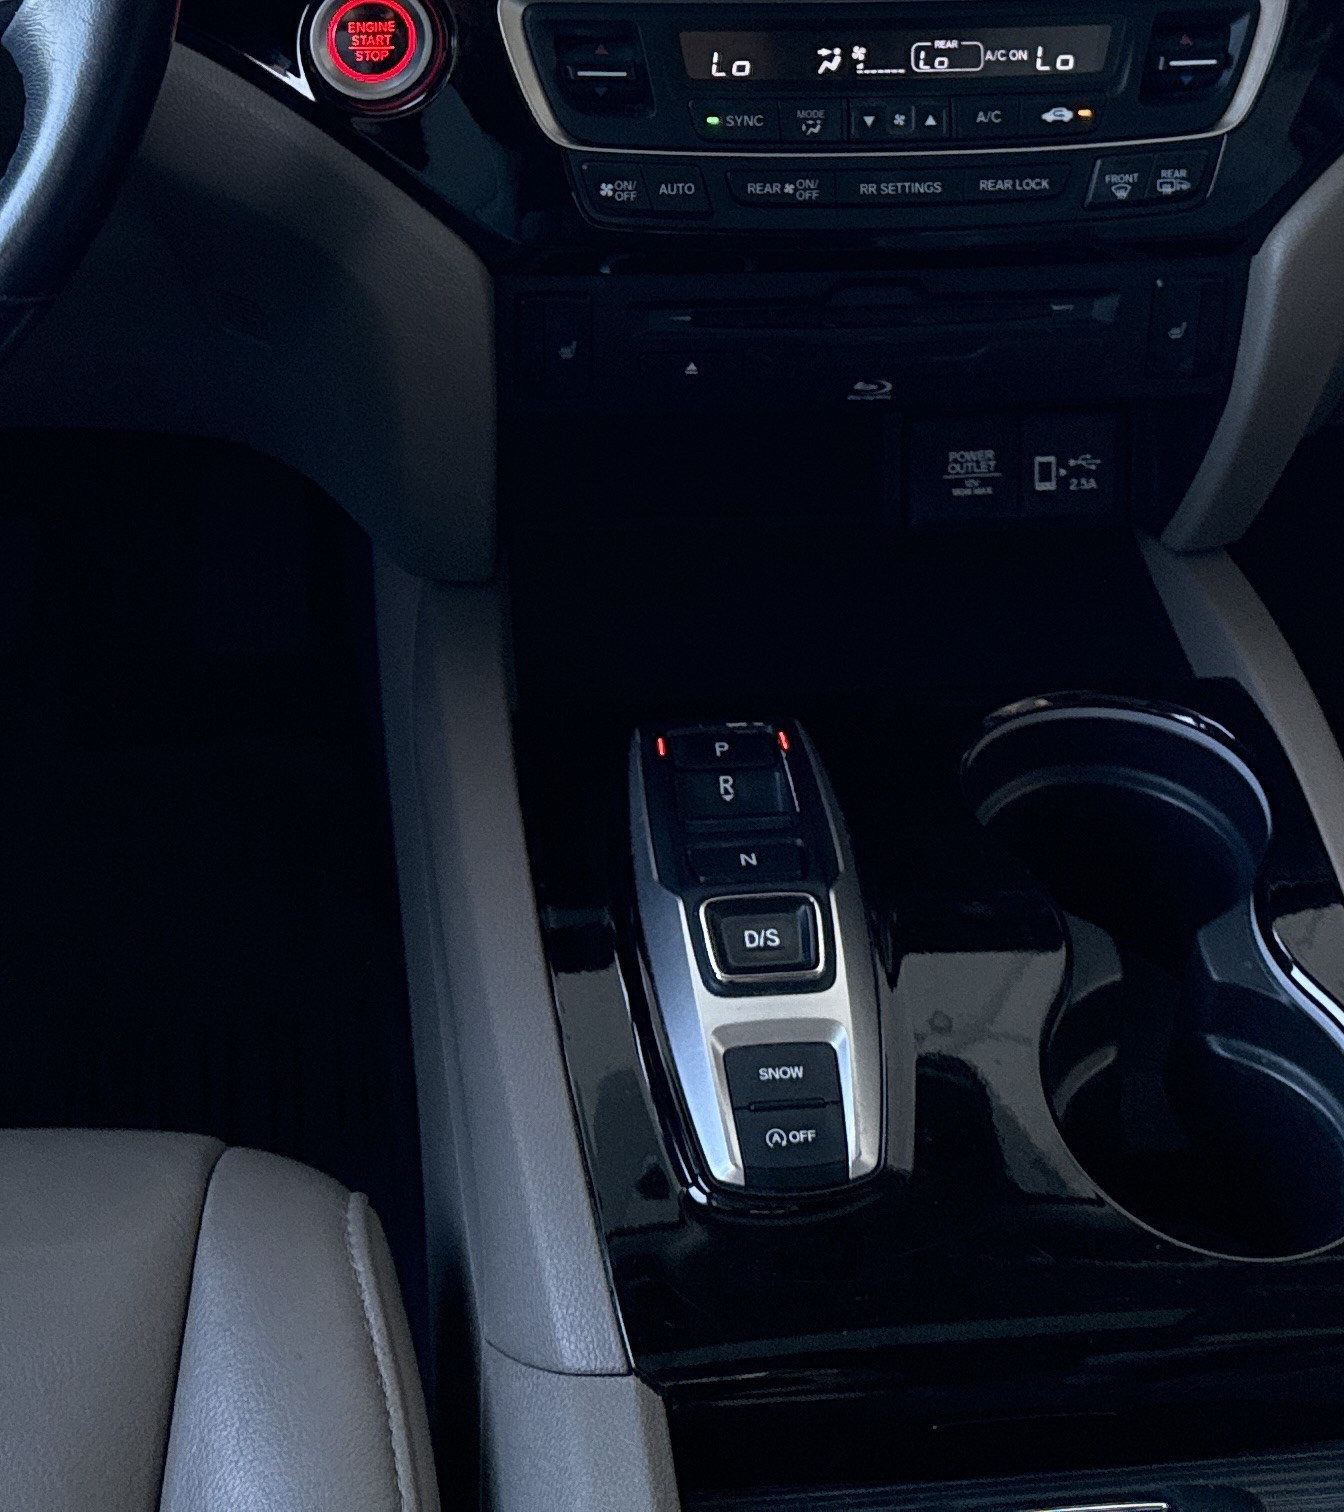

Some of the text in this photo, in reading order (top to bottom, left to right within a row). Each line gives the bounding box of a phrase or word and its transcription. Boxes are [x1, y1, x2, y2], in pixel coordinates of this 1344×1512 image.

[347, 21, 396, 34] ENGINE
[351, 34, 393, 46] START
[934, 40, 959, 49] REAR
[355, 50, 390, 62] STOP
[918, 50, 949, 70] Lo
[984, 50, 1028, 61] A/C ON
[1035, 45, 1075, 71] Lo
[711, 51, 751, 77] Lo
[796, 109, 825, 119] MODE
[976, 110, 1002, 123] A/C
[725, 115, 764, 127] SYNC
[1105, 173, 1139, 184] FRONT
[1160, 168, 1187, 178] REAR
[614, 180, 637, 190] ON/
[659, 183, 695, 195] AUTO
[747, 182, 781, 194] REAR
[796, 179, 819, 189] ON/
[859, 181, 943, 195] RR SETTINGS
[979, 178, 1050, 191] REAR LOCK
[614, 191, 637, 201] OFF
[796, 190, 819, 201] OFF
[948, 450, 995, 462] POWER
[947, 461, 997, 473] OUTLET
[715, 741, 729, 756] P
[719, 775, 734, 793] R
[739, 852, 758, 866] N
[743, 928, 780, 949] D/S
[758, 1066, 804, 1080] SNOW
[789, 1129, 816, 1143] OFF
